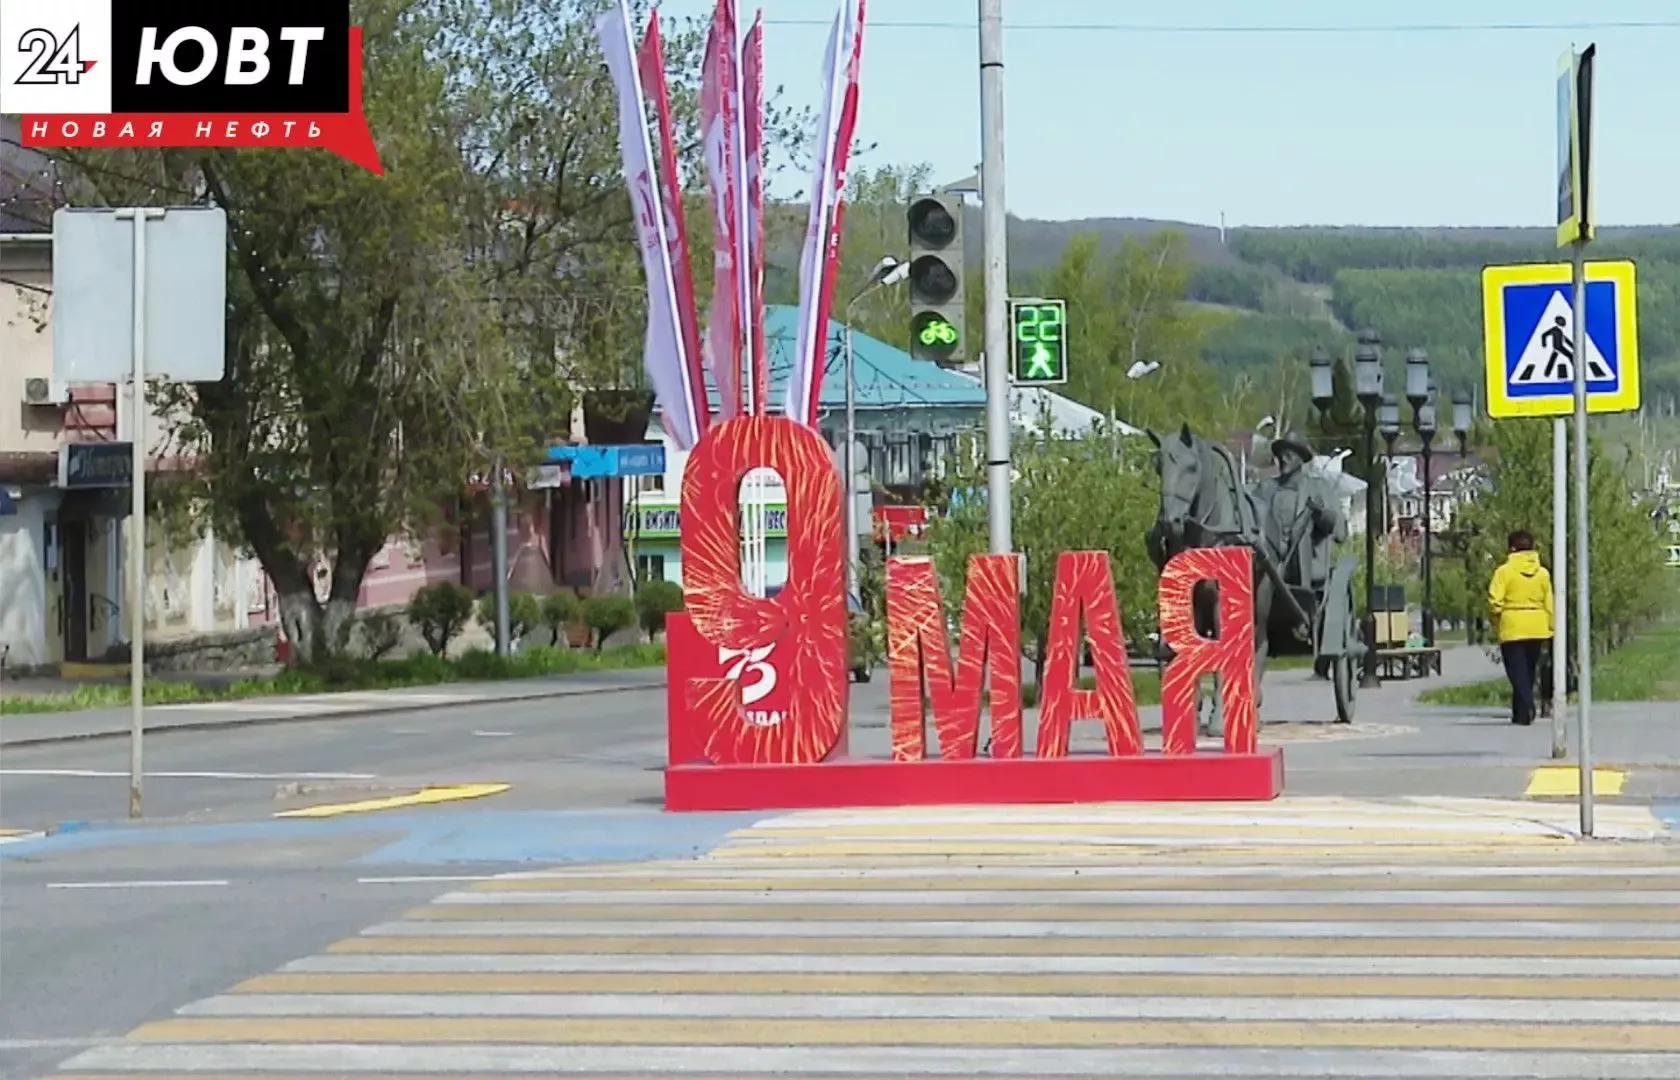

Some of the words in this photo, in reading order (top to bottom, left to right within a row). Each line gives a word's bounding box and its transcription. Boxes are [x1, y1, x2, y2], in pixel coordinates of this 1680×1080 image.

[1018, 305, 1060, 341] 22
[681, 416, 846, 766] 9
[886, 547, 1257, 761] МАЯ
